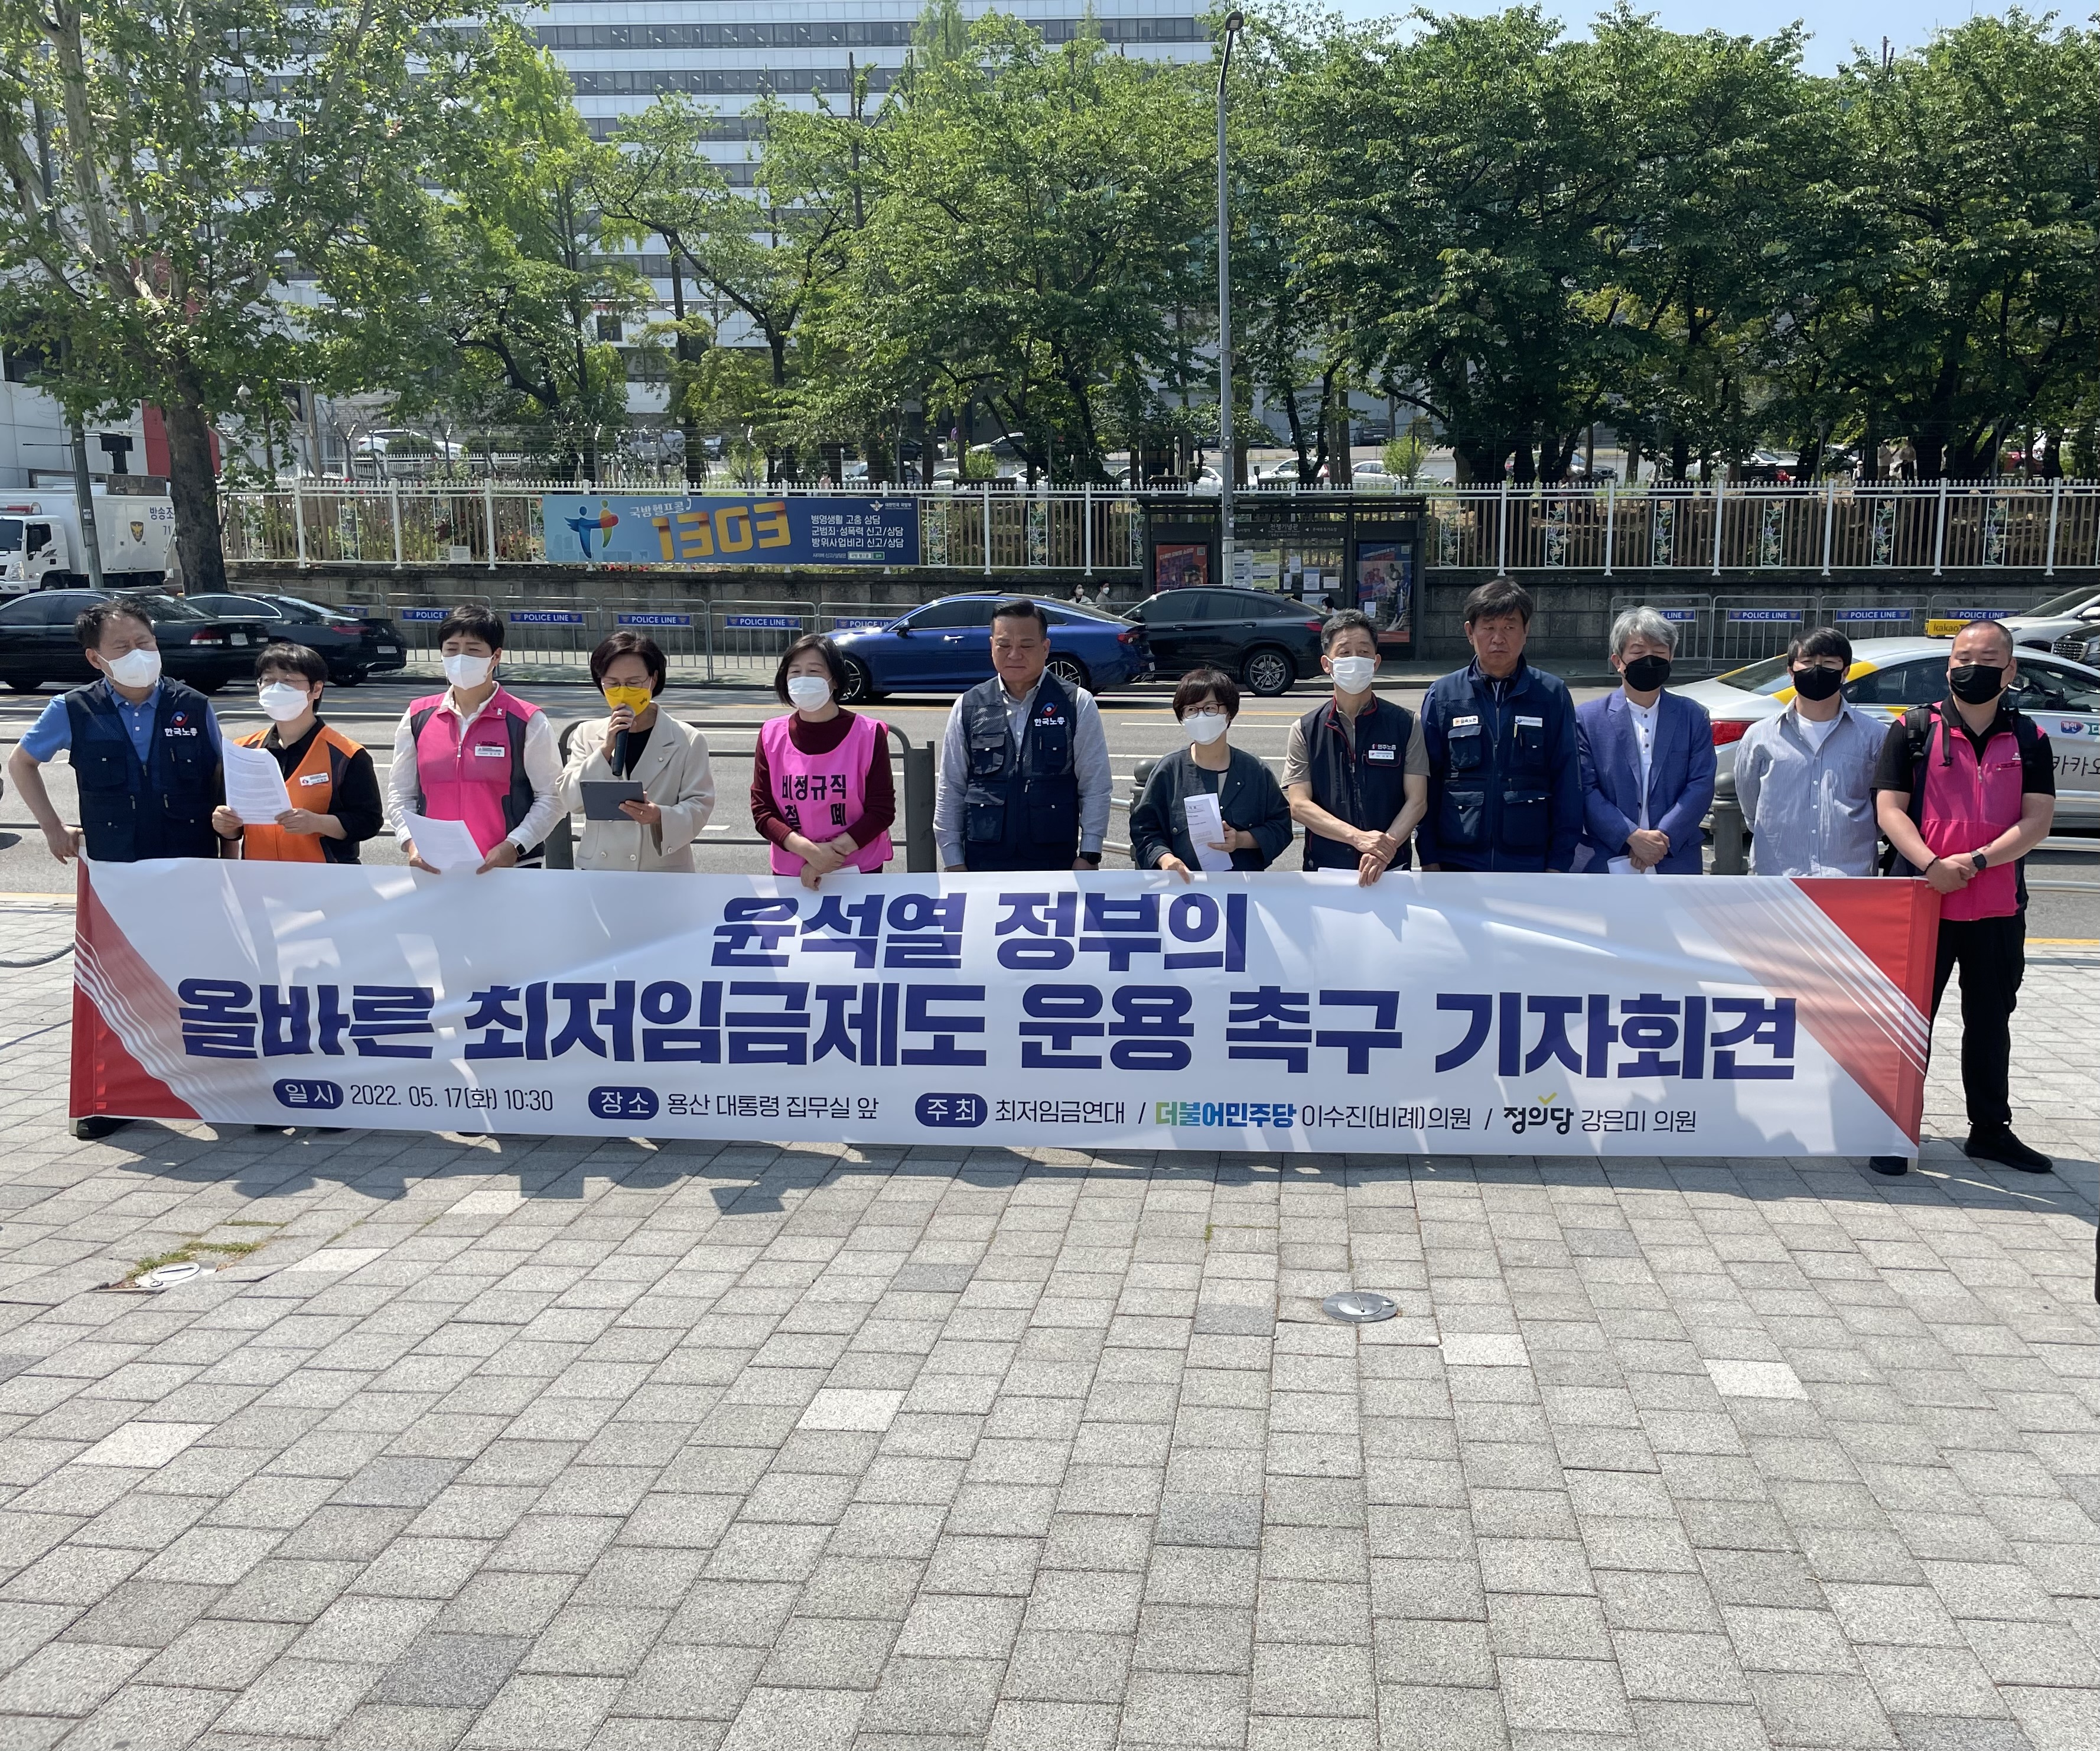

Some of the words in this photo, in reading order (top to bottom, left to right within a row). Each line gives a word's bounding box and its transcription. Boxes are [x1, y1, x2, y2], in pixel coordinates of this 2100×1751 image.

[629, 501, 685, 519] 국방헬프콜
[811, 515, 843, 525] 병영생활
[846, 515, 862, 525] 고충
[864, 515, 881, 525] 상담
[652, 501, 791, 561] 1303
[866, 526, 904, 536] 신고/상담
[811, 538, 864, 548] 방위사업비리
[867, 538, 904, 548] 신고/상담
[164, 727, 198, 737] 한국노총
[1034, 717, 1065, 727] 한국노총
[2063, 721, 2078, 732] 개인
[782, 774, 847, 800] 비정규직
[711, 893, 968, 969] 윤석열
[994, 891, 1248, 972] 정부의
[178, 978, 436, 1060] 올바른
[464, 979, 987, 1066] 최저임금제도
[1018, 984, 1194, 1071] 운용
[1226, 985, 1403, 1075] 촉구
[1435, 991, 1797, 1080] 기자회견
[350, 1085, 402, 1106] 2022.
[409, 1086, 438, 1107] 05.
[444, 1088, 497, 1110] 17(화)
[504, 1089, 554, 1111] 10:30
[667, 1093, 711, 1116] 용산
[717, 1094, 779, 1118] 대통령
[786, 1096, 850, 1119] 집무실
[857, 1096, 879, 1119] 앞
[995, 1099, 1125, 1124] 최저임금연대
[1155, 1101, 1297, 1128] 더불어민주당
[1503, 1106, 1575, 1135] 정의당
[1581, 1109, 1646, 1132] 강은미
[1653, 1110, 1697, 1133] 의원
